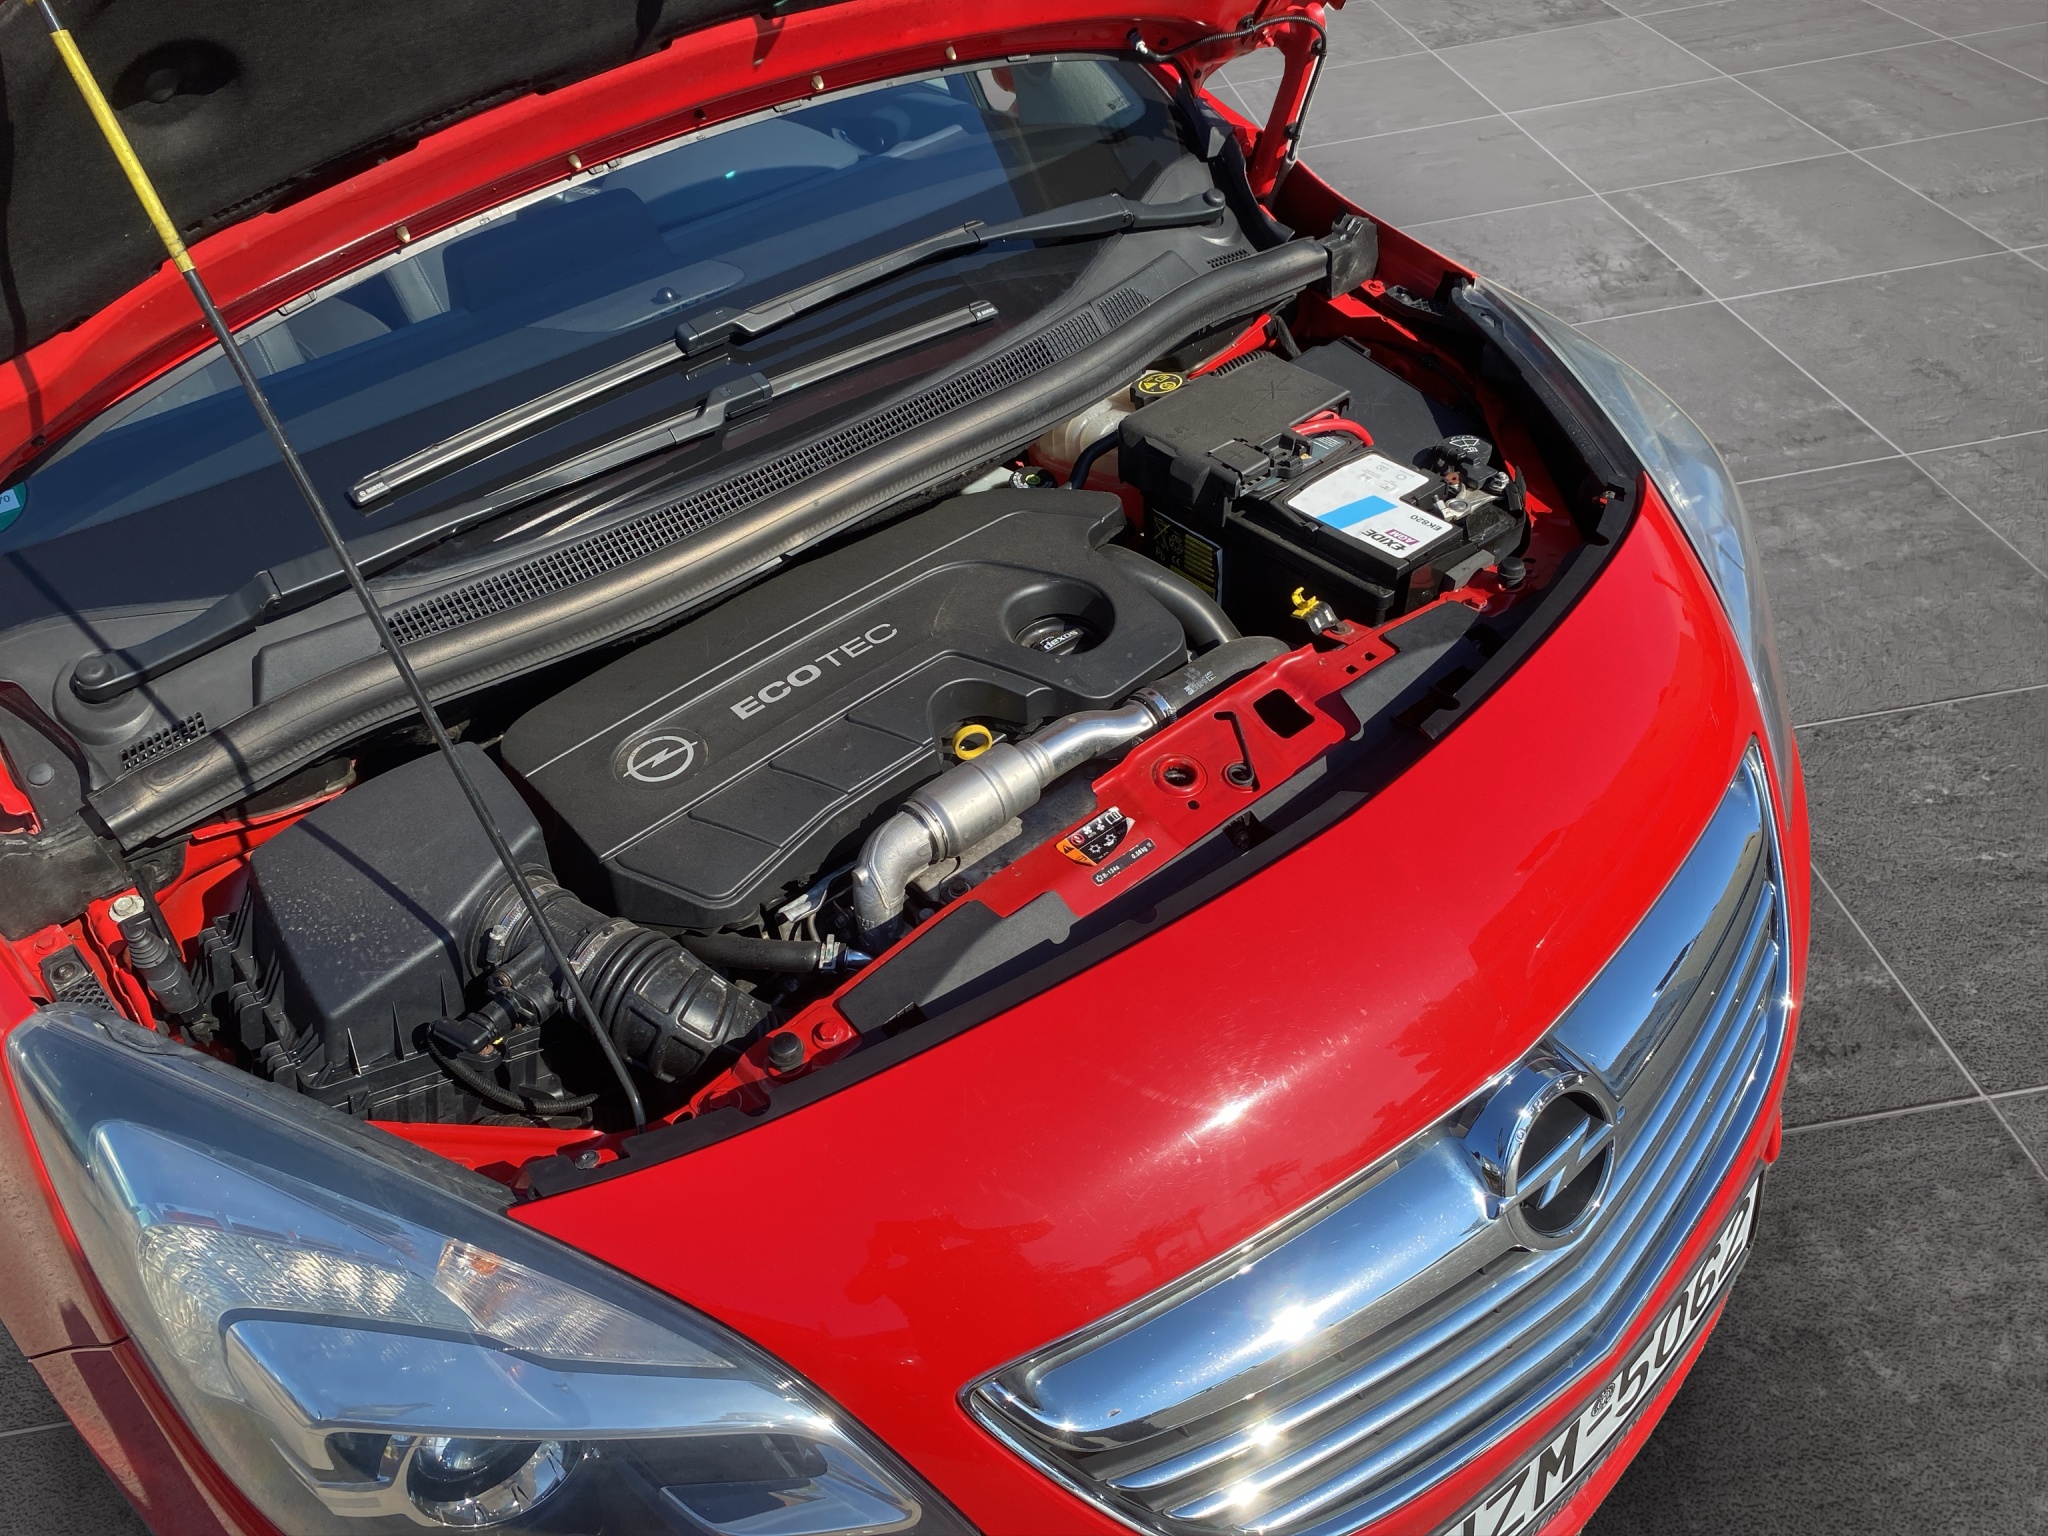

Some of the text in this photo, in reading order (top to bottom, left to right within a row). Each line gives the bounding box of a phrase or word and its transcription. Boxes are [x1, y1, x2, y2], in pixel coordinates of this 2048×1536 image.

[1411, 515, 1442, 531] EK820
[1362, 528, 1406, 551] EXIDE
[1389, 530, 1416, 544] AGM
[1043, 630, 1078, 650] dexos
[729, 623, 898, 720] ECOTEC
